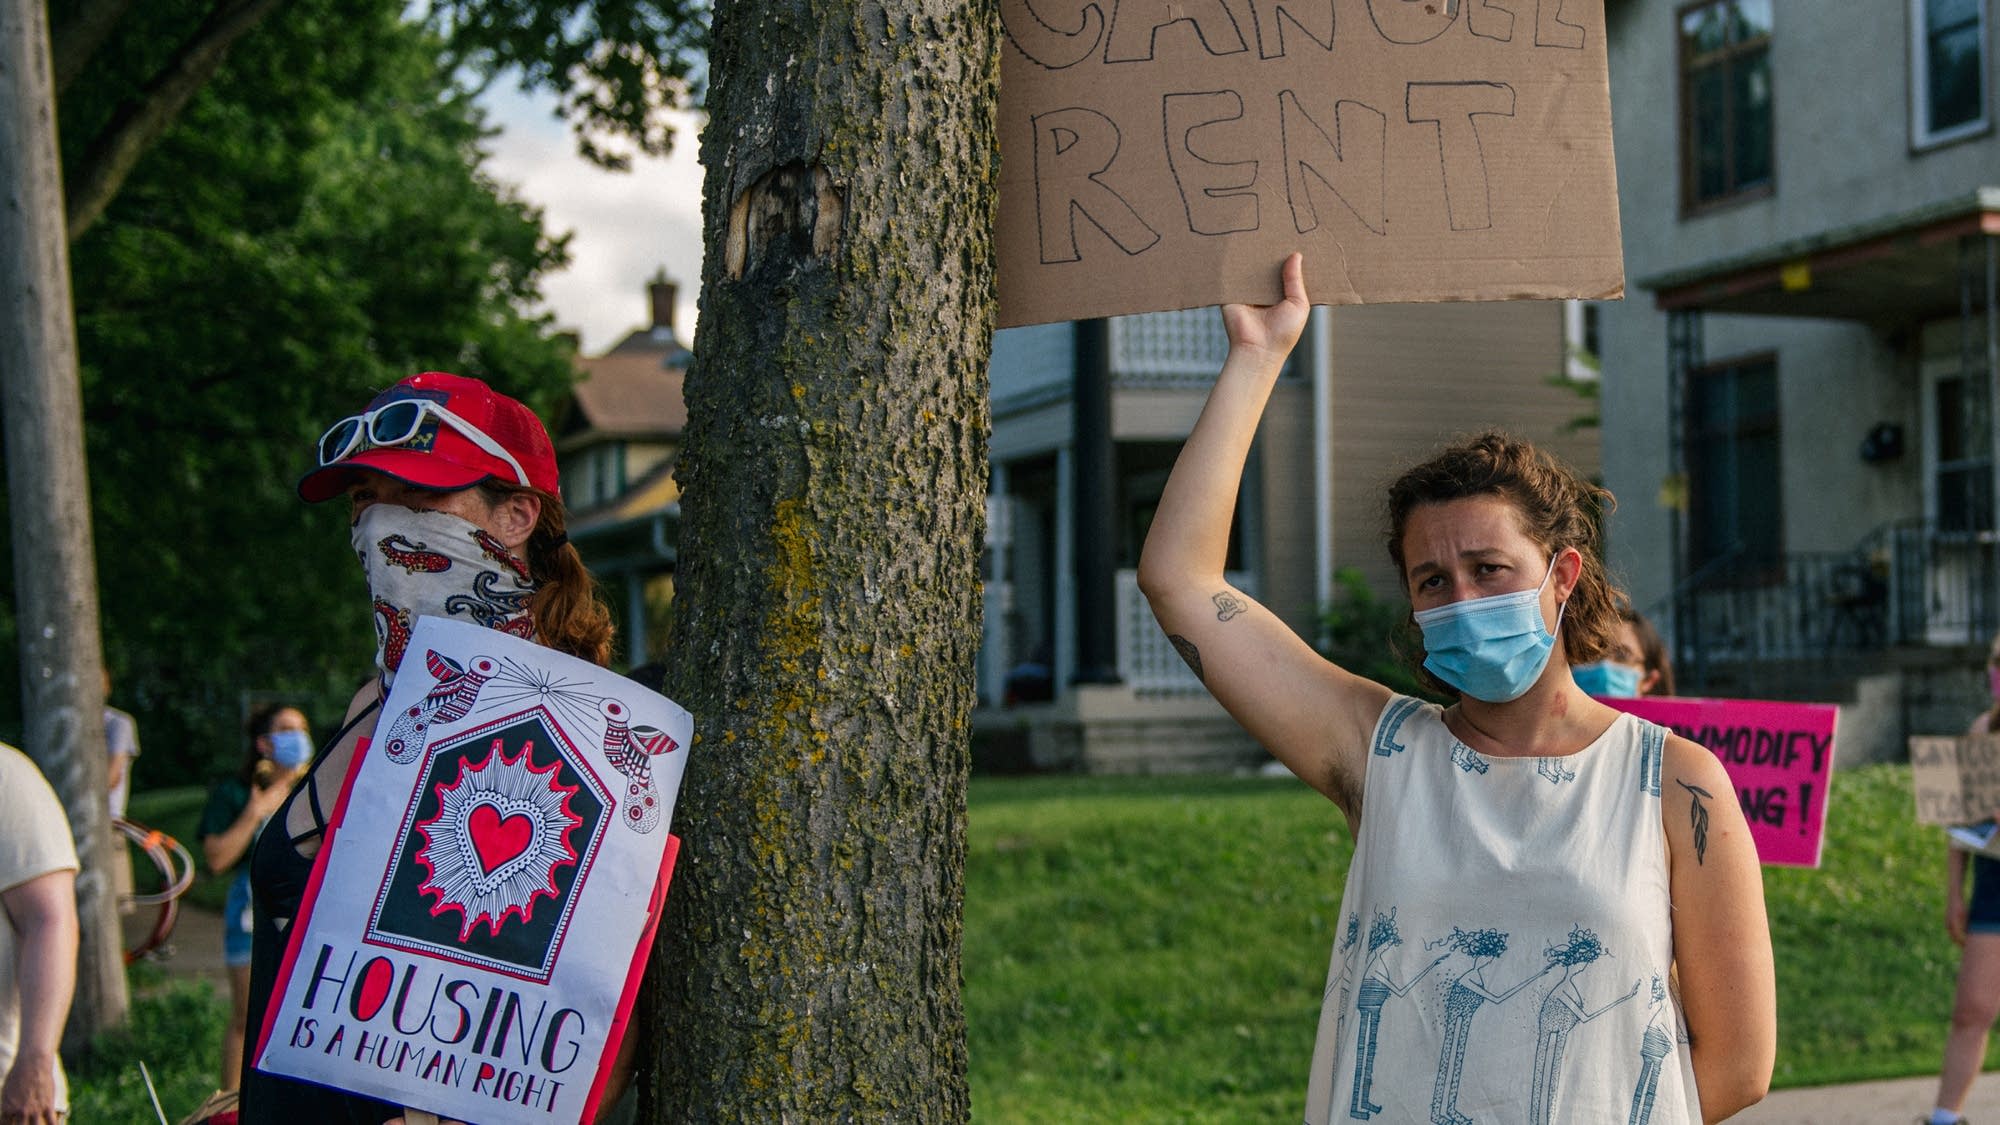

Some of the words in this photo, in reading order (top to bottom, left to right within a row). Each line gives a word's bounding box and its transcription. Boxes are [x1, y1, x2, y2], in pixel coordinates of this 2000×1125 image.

[1031, 81, 1516, 264] RENT
[290, 1016, 319, 1048] IS
[324, 1025, 345, 1056] A
[354, 1030, 467, 1088] HUMAN
[472, 1062, 564, 1112] RIGHT
[302, 944, 585, 1073] HOUSING
